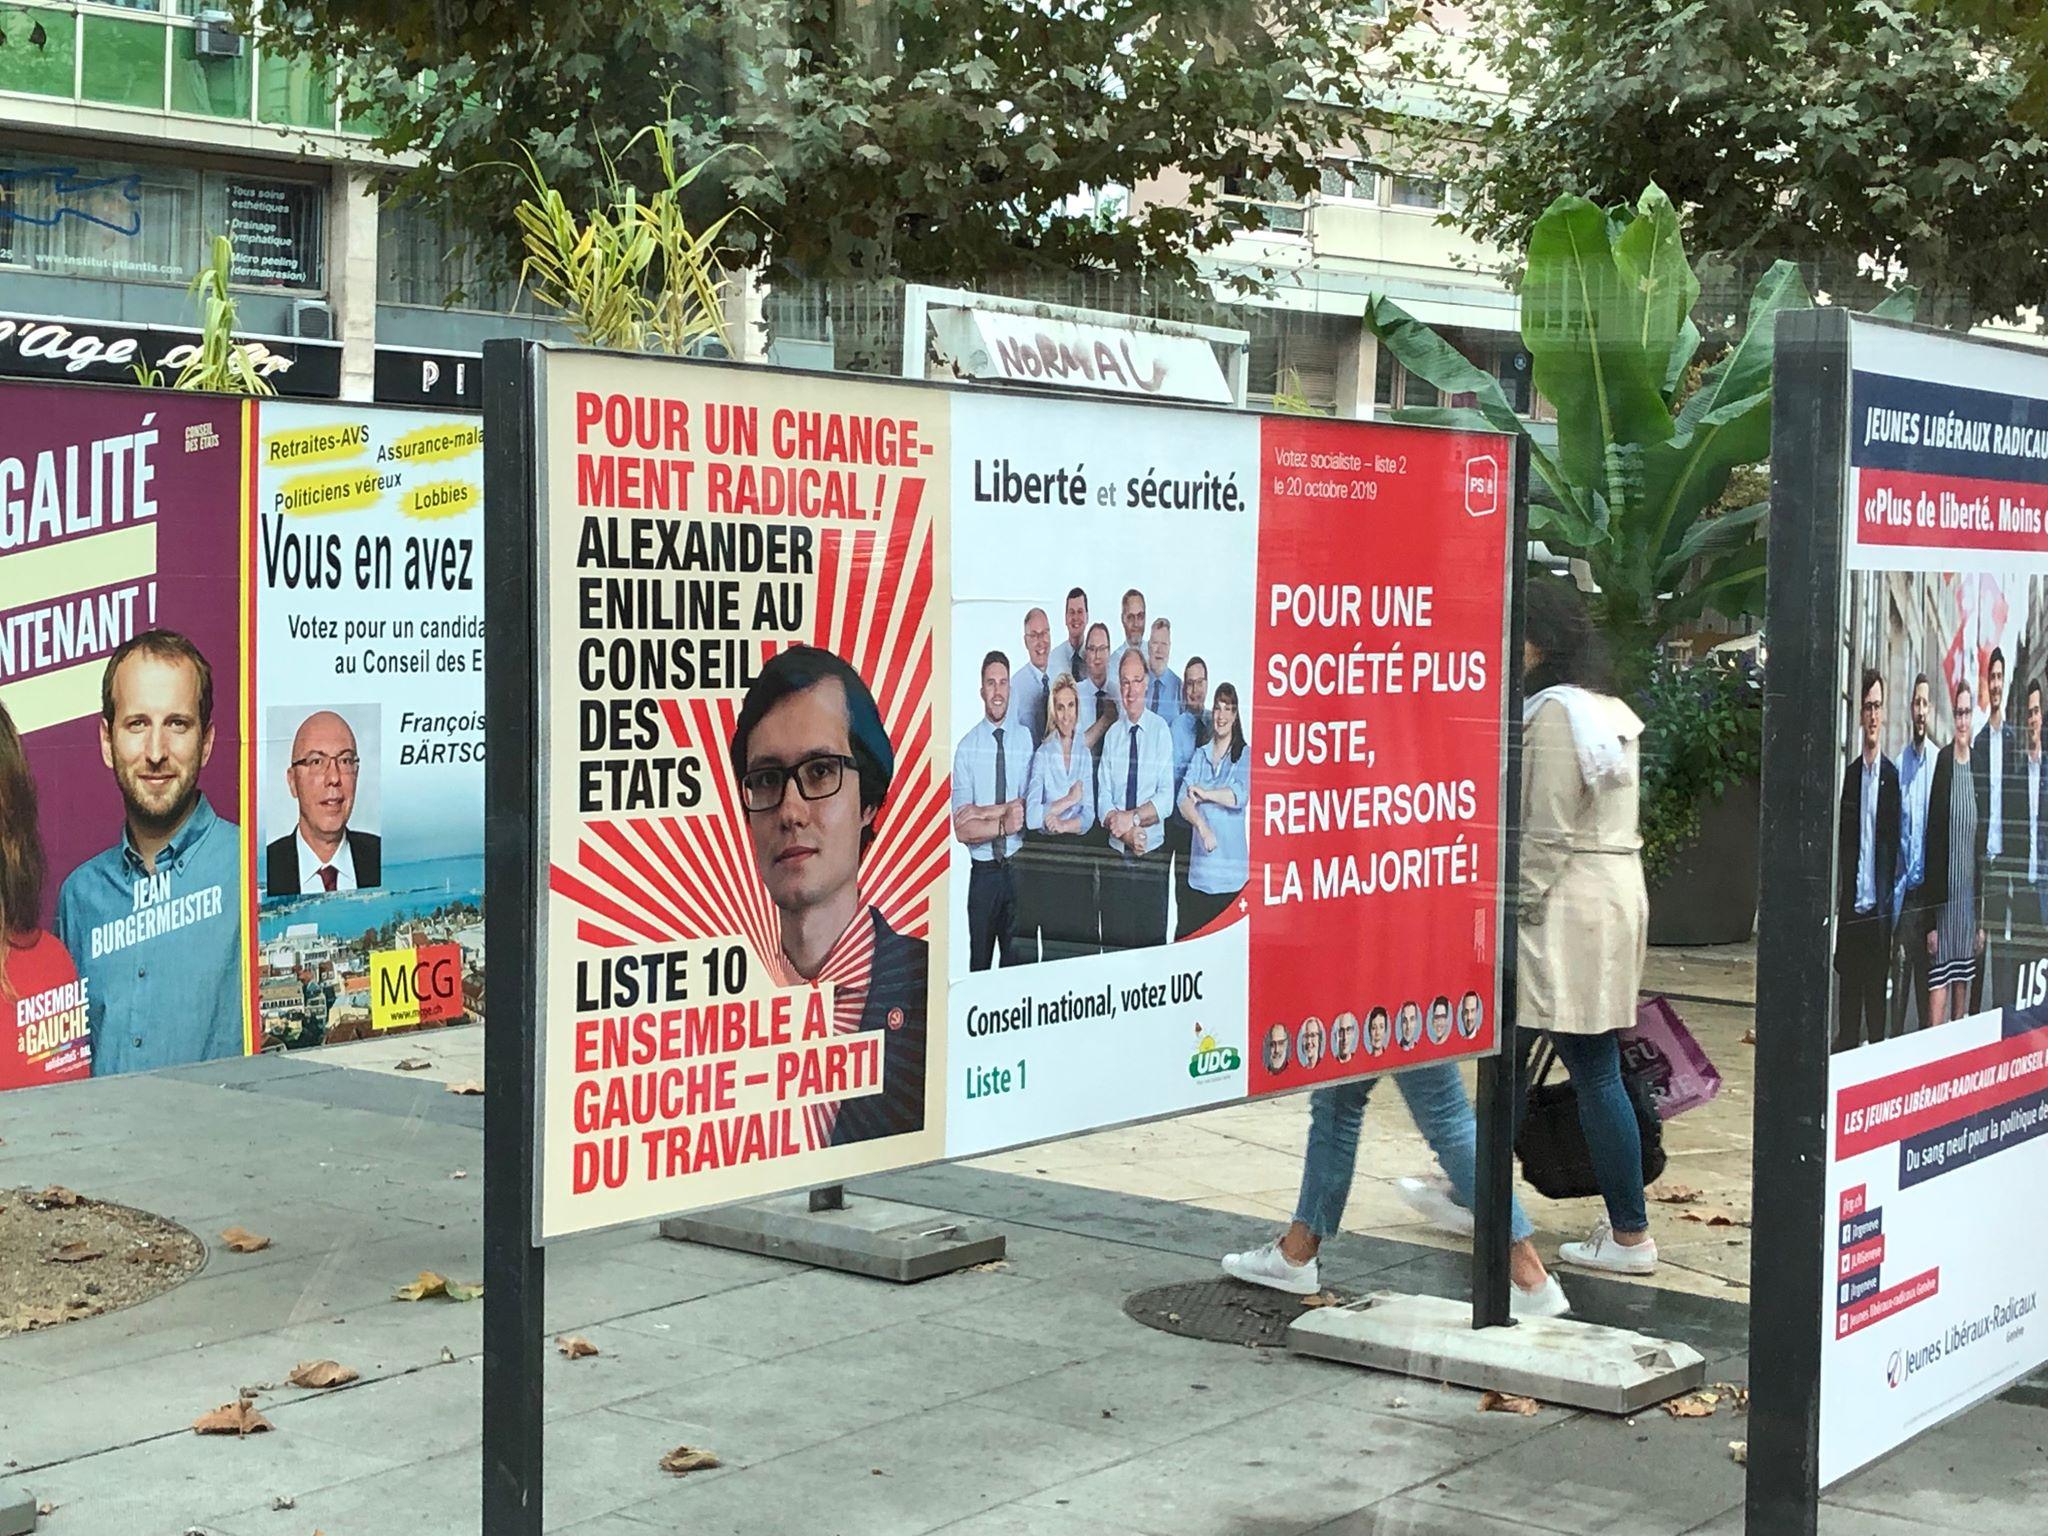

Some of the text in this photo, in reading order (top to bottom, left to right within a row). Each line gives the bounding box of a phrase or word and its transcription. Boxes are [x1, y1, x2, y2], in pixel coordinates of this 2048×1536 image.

[233, 186, 285, 200] Tous soins
[232, 218, 277, 234] Drainage
[232, 232, 293, 248] ymphatique
[230, 265, 307, 283] (dermabrasion)
[261, 256, 299, 270] peeling
[270, 425, 370, 461] Retraites-AVS
[576, 391, 933, 468] POUR UN CHANGE-
[1864, 406, 1920, 447] JEUNES
[1923, 410, 1992, 453] LIBÉRAUX
[577, 454, 694, 511] MENT
[1275, 447, 1307, 467] Votez
[1311, 451, 1361, 472] socialiste
[1374, 455, 1396, 473] liste
[1399, 456, 1407, 474] 2
[275, 473, 402, 512] Politiciens véreux
[415, 484, 468, 511] Lobbies
[974, 459, 1245, 512] Liberté et sécurité.
[1274, 477, 1377, 500] le 20 octobre 2019
[1470, 477, 1484, 493] PS
[1864, 487, 1912, 527] «Plus
[1917, 491, 1935, 528] de
[1940, 492, 1994, 531] liberté.
[1998, 498, 2041, 534] Moins
[261, 513, 473, 591] Vous en avez
[576, 516, 813, 574] ALEXANDER
[579, 577, 803, 631] ENILINE AU
[1270, 584, 1433, 627] POUR UNE
[288, 615, 338, 639] Votez
[345, 619, 386, 644] pour
[393, 620, 413, 639] un
[335, 654, 356, 674] au
[363, 650, 430, 674] Conseil
[436, 650, 465, 672] des
[579, 637, 762, 691] CONSEIL
[1267, 641, 1486, 697] SOCIÉTÉ PLUS
[400, 711, 486, 736] François
[579, 698, 660, 752] DES
[1264, 720, 1375, 768] JUSTE,
[579, 756, 702, 813] ETATS
[1264, 779, 1476, 836] RENVERSONS
[132, 871, 172, 912] JEAN
[1264, 861, 1303, 906] LA
[92, 885, 223, 960] BURGERMEISTER
[17, 977, 89, 1028] ENSEMBLE
[381, 959, 454, 1006] MCG
[576, 945, 748, 1012] LISTE 10
[574, 981, 827, 1073] ENSEMBLE À
[967, 971, 1203, 1038] Conseil national, votez UDC
[26, 1004, 90, 1056] GAUCHE
[967, 1059, 1026, 1099] Liste 1
[1197, 1049, 1232, 1074] UDC
[573, 1060, 737, 1134] GAUCHE
[777, 1039, 879, 1101] PARTI
[1844, 1109, 1864, 1135] LES
[1864, 1096, 1903, 1133] JEUNES
[1903, 1066, 1997, 1116] LIBÉRAUX-RADICAUX
[1996, 1061, 2009, 1084] AU
[2010, 1050, 2043, 1079] CONSEIL
[573, 1107, 800, 1195] DU TRAVAIL
[1906, 1149, 1920, 1172] Du
[1922, 1143, 1945, 1165] sang
[1946, 1127, 1968, 1157] neuf
[1968, 1125, 1989, 1154] pour
[1990, 1118, 1998, 1140] la
[2000, 1107, 2037, 1141] politique
[1905, 1291, 2037, 1381] Jeunes Libéraux-Radicaux
